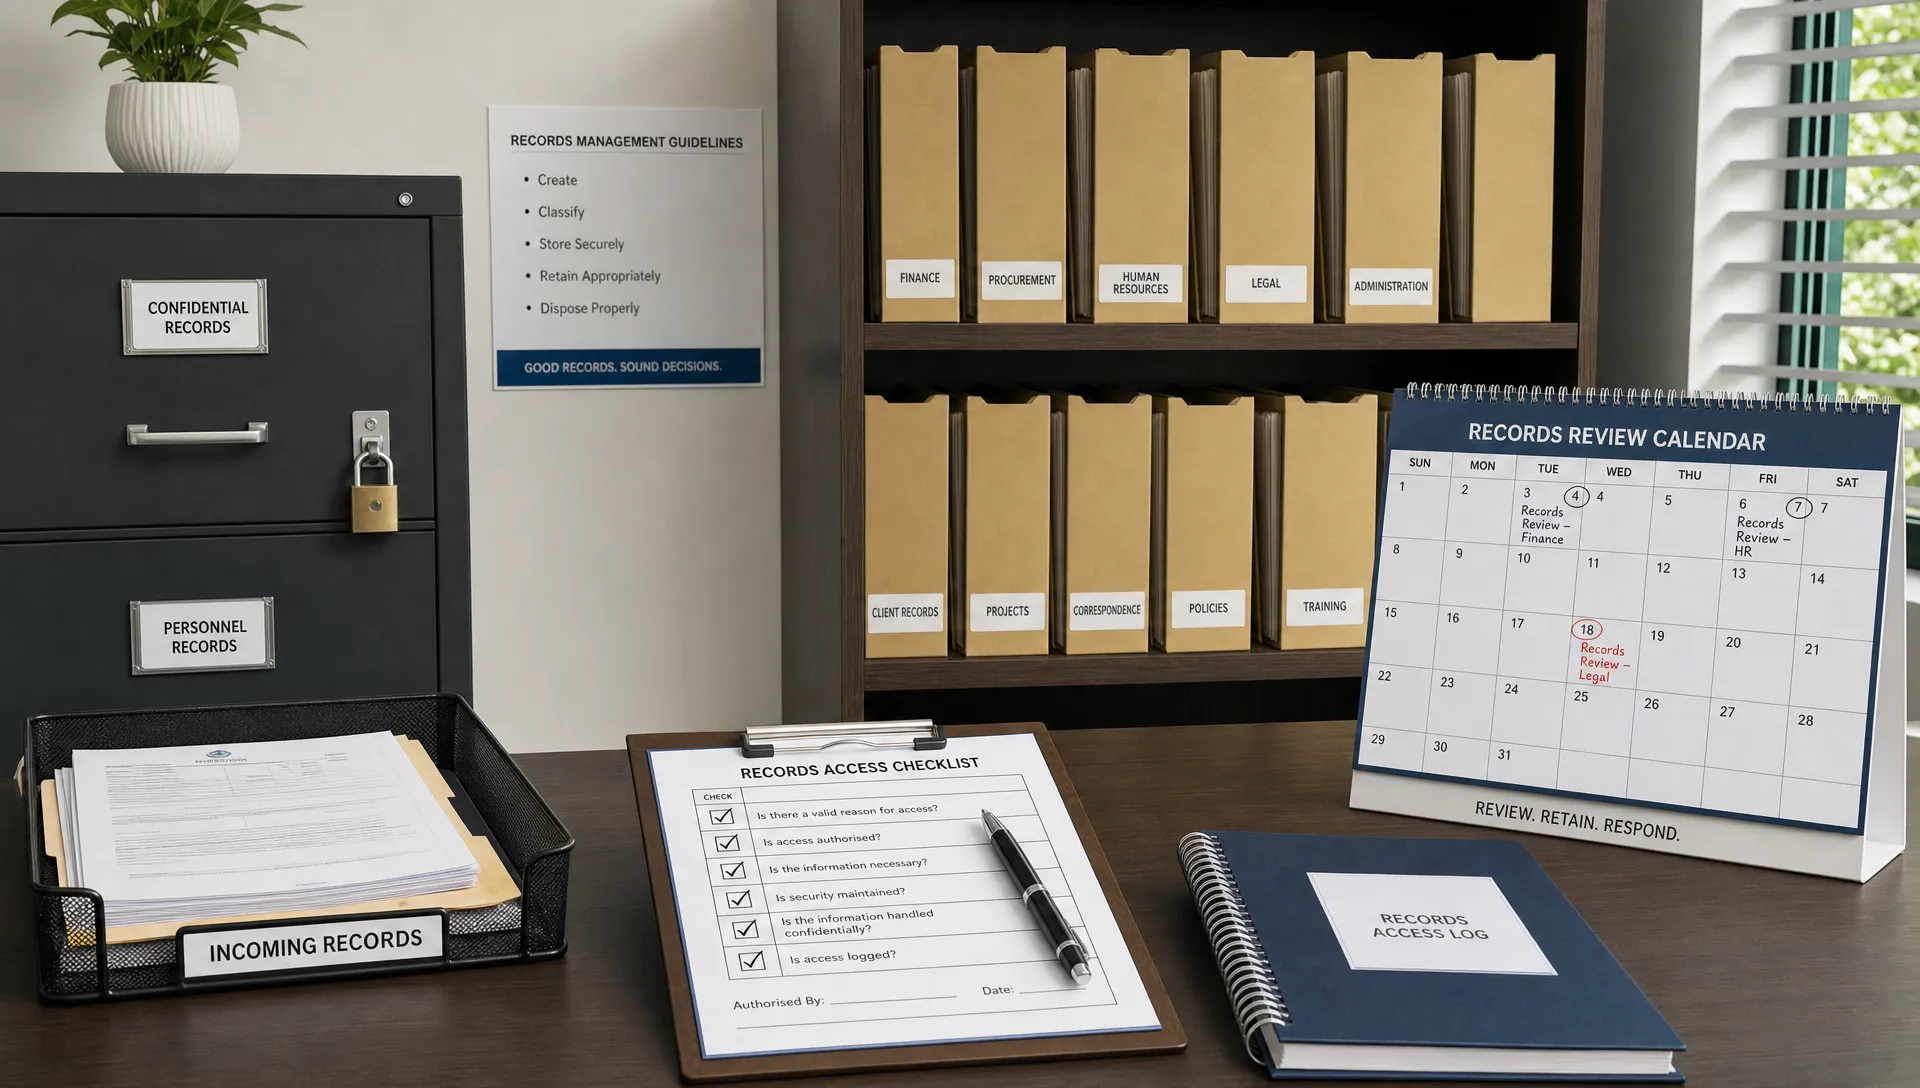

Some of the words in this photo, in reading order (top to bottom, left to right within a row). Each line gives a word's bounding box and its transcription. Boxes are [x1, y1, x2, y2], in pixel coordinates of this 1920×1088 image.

[510, 134, 573, 147] RECORDS
[576, 135, 666, 148] MANAGEMENT
[668, 136, 744, 149] GUIDELINES
[537, 173, 578, 187] Create
[538, 205, 585, 222] Classify
[539, 237, 572, 250] Store
[574, 237, 625, 253] Securely
[540, 269, 579, 282] Retain
[581, 269, 661, 285] Appropriately
[900, 272, 941, 284] FINANCE
[988, 274, 1057, 286] PROCUREMENT
[1122, 271, 1160, 282] HUMAN
[1251, 277, 1282, 289] LEGAL
[1113, 283, 1169, 295] RESOURCES
[1354, 280, 1429, 292] ADMINISTRATION
[148, 300, 249, 315] CONFIDENTIAL
[540, 302, 588, 318] Dispose
[591, 301, 641, 318] Properly
[165, 320, 231, 334] RECORDS
[524, 362, 560, 374] GOOD
[562, 361, 618, 373] RECORDS.
[619, 361, 660, 373] SOUND
[661, 360, 723, 372] DECISIONS.
[1468, 422, 1563, 444] RECORDS
[1568, 426, 1648, 447] REVIEW
[1653, 429, 1766, 452] CALENDAR
[1409, 457, 1431, 468] SUN
[1469, 460, 1496, 471] MON
[1537, 463, 1560, 474] TUE
[1606, 466, 1632, 478] WED
[1678, 469, 1702, 481] THU
[1759, 473, 1777, 484] FRI
[1836, 476, 1859, 488] SAT
[1399, 481, 1405, 492] 1
[1461, 484, 1469, 495] 2
[1523, 487, 1531, 499] 3
[1596, 491, 1604, 502] 4
[1664, 494, 1672, 506] 5
[1739, 498, 1747, 510] 6
[1820, 502, 1829, 514] 7
[1571, 490, 1579, 502] 4
[1521, 504, 1564, 518] Records
[1794, 501, 1803, 513] 7
[1522, 518, 1560, 531] Review
[1736, 516, 1785, 530] Records
[1521, 531, 1564, 545] Finance
[1736, 531, 1778, 544] Review
[1734, 545, 1753, 558] HR
[1392, 543, 1400, 555] 8
[1455, 547, 1463, 559] 9
[1517, 552, 1531, 564] 10
[1588, 557, 1599, 569] 11
[1657, 562, 1671, 574] 12
[1732, 567, 1746, 580] 13
[1810, 572, 1825, 585] 14
[871, 606, 900, 619] CLIENT
[901, 606, 939, 618] RECORDS
[986, 605, 1030, 617] PROJECTS
[1073, 604, 1141, 616] CORRESPONDENCE
[1189, 602, 1229, 614] POLICIES
[1303, 600, 1347, 612] TRAINING
[164, 619, 248, 635] PERSONNEL
[1384, 606, 1397, 618] 15
[1446, 612, 1460, 624] 16
[1511, 617, 1525, 629] 17
[1580, 624, 1594, 636] 18
[1651, 629, 1665, 642] 19
[1725, 636, 1742, 649] 20
[1804, 642, 1819, 656] 21
[172, 639, 238, 654] RECORDS
[1581, 642, 1626, 657] Records
[1580, 656, 1619, 670] Review
[1579, 669, 1611, 685] Legal
[1377, 669, 1392, 682] 22
[1440, 676, 1455, 688] 23
[1504, 682, 1519, 695] 24
[1573, 690, 1589, 703] 25
[1644, 697, 1660, 710] 26
[1719, 705, 1736, 718] 27
[1797, 714, 1814, 727] 28
[1370, 733, 1385, 745] 29
[1433, 740, 1448, 753] 30
[1497, 748, 1511, 761] 31
[740, 764, 820, 780] RECORDS
[824, 761, 888, 776] ACCESS
[892, 757, 979, 772] CHECKLIST
[703, 793, 733, 801] CHECK
[757, 812, 767, 820] Is
[769, 811, 799, 820] there
[811, 808, 838, 817] valid
[840, 808, 877, 816] reason
[879, 806, 895, 815] for
[898, 804, 938, 814] access?
[1475, 801, 1536, 823] REVIEW.
[1540, 809, 1598, 831] RETAIN.
[1604, 818, 1680, 842] RESPOND.
[763, 838, 773, 847] Is
[776, 838, 814, 846] access
[816, 833, 881, 844] authorised?
[769, 865, 779, 874] Is
[781, 865, 800, 874] the
[802, 861, 867, 872] information
[869, 858, 928, 869] necessary?
[775, 894, 786, 902] Is
[789, 891, 834, 902] security
[837, 887, 906, 899] maintained?
[781, 917, 792, 926] Is
[794, 916, 815, 925] the
[817, 912, 884, 924] information
[886, 908, 934, 920] handled
[1380, 913, 1469, 926] RECORDS
[784, 925, 872, 937] confidentially?
[1373, 927, 1445, 939] ACCESS
[1448, 929, 1489, 940] LOG
[210, 937, 317, 963] INCOMING
[323, 928, 423, 954] RECORDS
[789, 955, 801, 964] Is
[804, 954, 845, 964] access
[847, 949, 896, 963] logged?
[982, 986, 1014, 996] Date:
[733, 996, 802, 1010] Authorised
[805, 996, 825, 1007] By:
